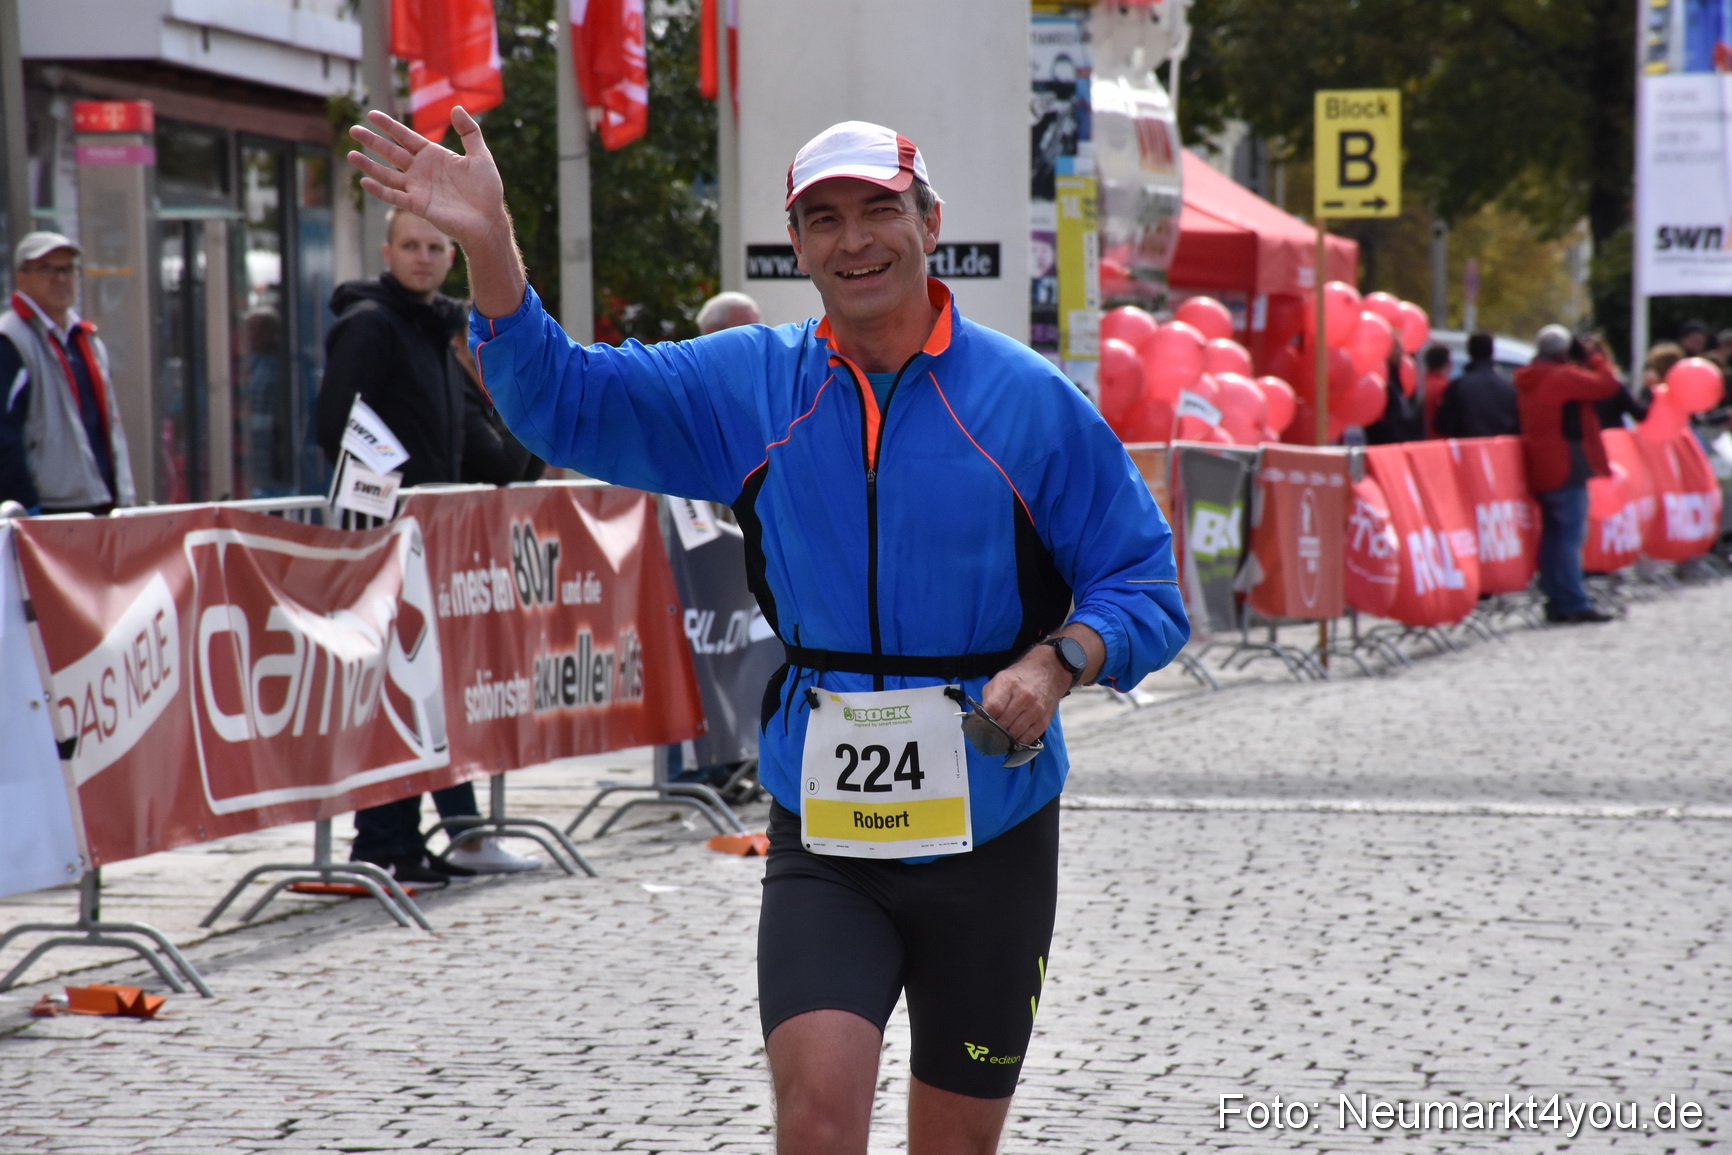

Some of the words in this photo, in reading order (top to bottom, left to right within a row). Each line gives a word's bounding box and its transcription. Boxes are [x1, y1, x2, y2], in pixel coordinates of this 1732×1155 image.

[1326, 96, 1390, 119] Block
[1339, 131, 1378, 187] B
[1656, 225, 1723, 251] swn
[452, 551, 515, 617] meisten
[561, 572, 582, 605] und
[583, 572, 602, 604] die
[124, 608, 171, 720] NEUE
[853, 705, 911, 722] BOCK
[835, 741, 925, 792] 224
[810, 782, 815, 790] D
[853, 811, 910, 829] Robert
[989, 1055, 1021, 1065] edition
